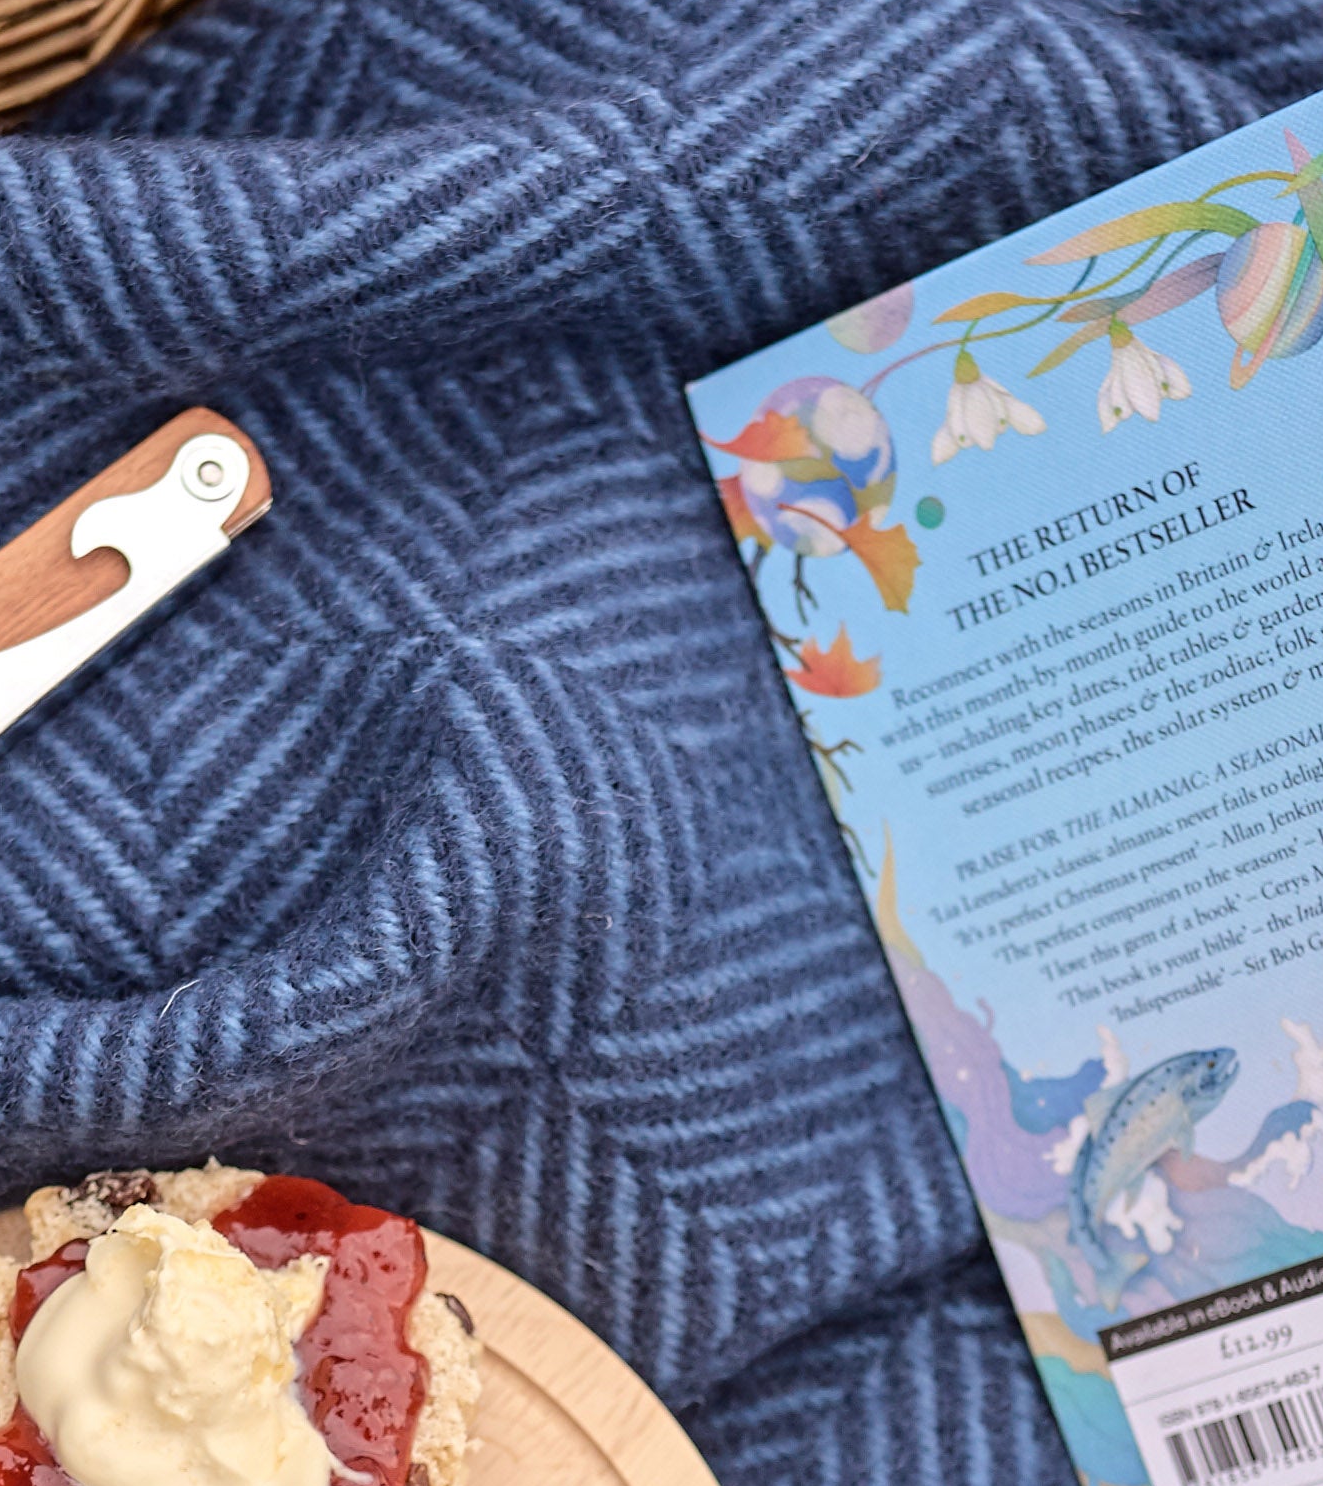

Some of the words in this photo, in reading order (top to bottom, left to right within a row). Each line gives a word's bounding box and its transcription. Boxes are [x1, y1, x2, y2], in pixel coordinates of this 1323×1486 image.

[945, 589, 1006, 632] THE
[1010, 561, 1078, 607] NO.1
[1078, 487, 1258, 579] BESTSELLER
[966, 533, 1035, 578] THE
[1032, 479, 1159, 553] RETURN
[1160, 460, 1201, 497] OF
[878, 715, 927, 749] with
[923, 705, 965, 732] this
[963, 630, 1133, 716] month-by-month
[1132, 608, 1189, 653] guide
[1189, 603, 1215, 624] to
[1214, 586, 1249, 614] the
[1250, 554, 1314, 598] world
[889, 656, 995, 711] Reconnect
[994, 633, 1043, 667] with
[1041, 622, 1076, 649] the
[1076, 592, 1155, 635] seasons
[1153, 581, 1178, 603] in
[1175, 551, 1251, 594] Britain
[1252, 536, 1275, 563] &
[937, 711, 1033, 761] including
[1027, 697, 1064, 723] key
[1067, 675, 1129, 708] dates,
[1126, 652, 1167, 684] tide
[1168, 630, 1231, 668] tables
[1231, 614, 1253, 642] &
[960, 765, 1045, 818] seasonal
[1044, 747, 1123, 786] recipes,
[1120, 728, 1155, 755] the
[1155, 708, 1207, 742] solar
[1208, 681, 1280, 722] system
[1281, 664, 1303, 691] &
[1009, 730, 1070, 765] moon
[1068, 704, 1138, 748] phases
[1139, 687, 1161, 713] &
[1163, 677, 1198, 704] the
[1198, 648, 1275, 690] zodiac;
[1274, 625, 1319, 659] folk
[954, 843, 1017, 883] PRAISE
[1017, 827, 1063, 858] FOR
[1062, 810, 1103, 840] THE
[1109, 769, 1211, 824] ALMANAC:
[1214, 761, 1229, 784] A
[986, 923, 999, 938] a
[997, 900, 1054, 938] perfect
[1053, 870, 1139, 911] Christmas
[1221, 821, 1267, 849] Allan
[1051, 849, 1104, 879] classic
[1105, 821, 1175, 859] almanac
[1174, 803, 1220, 832] never
[1220, 785, 1259, 814] fails
[1259, 781, 1280, 799] to
[1033, 920, 1090, 957] perfect
[1089, 886, 1183, 932] companion
[1182, 879, 1204, 897] to
[1202, 866, 1232, 890] the
[1088, 944, 1122, 966] this
[1121, 929, 1159, 959] gem
[1158, 915, 1179, 940] of
[1182, 916, 1195, 932] a
[1259, 874, 1311, 901] Cerys
[1100, 964, 1146, 995] book
[1146, 962, 1164, 978] is
[1162, 946, 1202, 976] your
[1265, 911, 1294, 934] the
[1242, 956, 1268, 977] Sir
[1268, 938, 1306, 967] Bob
[1218, 1324, 1294, 1360] £12.99
[1261, 1280, 1280, 1304] &
